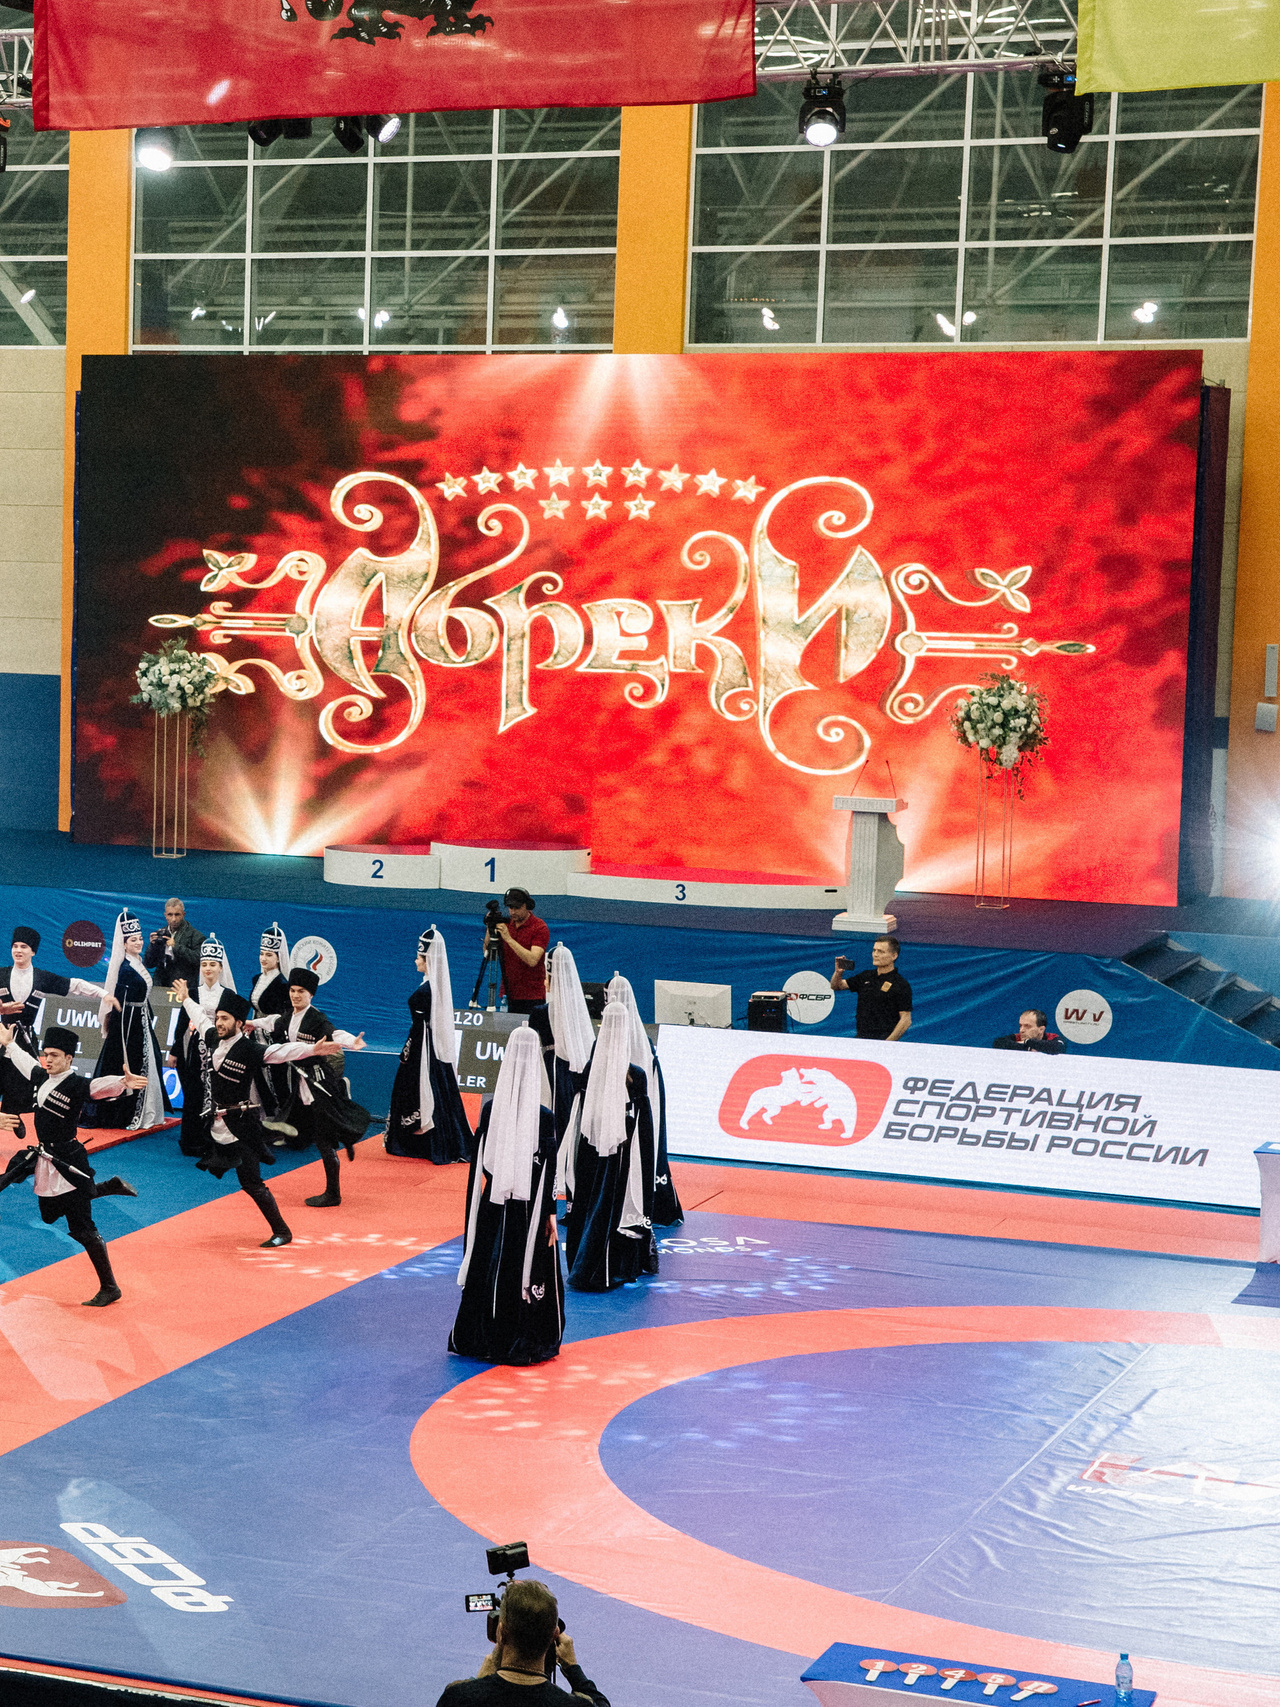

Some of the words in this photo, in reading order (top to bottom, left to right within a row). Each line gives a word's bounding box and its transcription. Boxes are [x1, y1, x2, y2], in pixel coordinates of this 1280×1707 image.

[370, 859, 384, 879] 2
[484, 857, 496, 883] 1
[674, 883, 687, 901] 3
[73, 940, 102, 948] OLIMPBET
[799, 993, 831, 1001] ФСБР
[56, 1008, 100, 1029] UWW
[475, 1041, 507, 1061] UW
[457, 1074, 487, 1088] LER
[901, 1076, 1143, 1114] ФЕДЕРАЦИЯ
[892, 1098, 1158, 1138] СПОРТИВНОЙ
[883, 1121, 1041, 1151] БОРЬБЫ
[1045, 1133, 1209, 1168] РОССИИ
[660, 1236, 770, 1247] OSA
[59, 1522, 235, 1613] ФСБР
[909, 1664, 928, 1675] 2
[944, 1669, 966, 1679] 4
[987, 1674, 1005, 1684] 5
